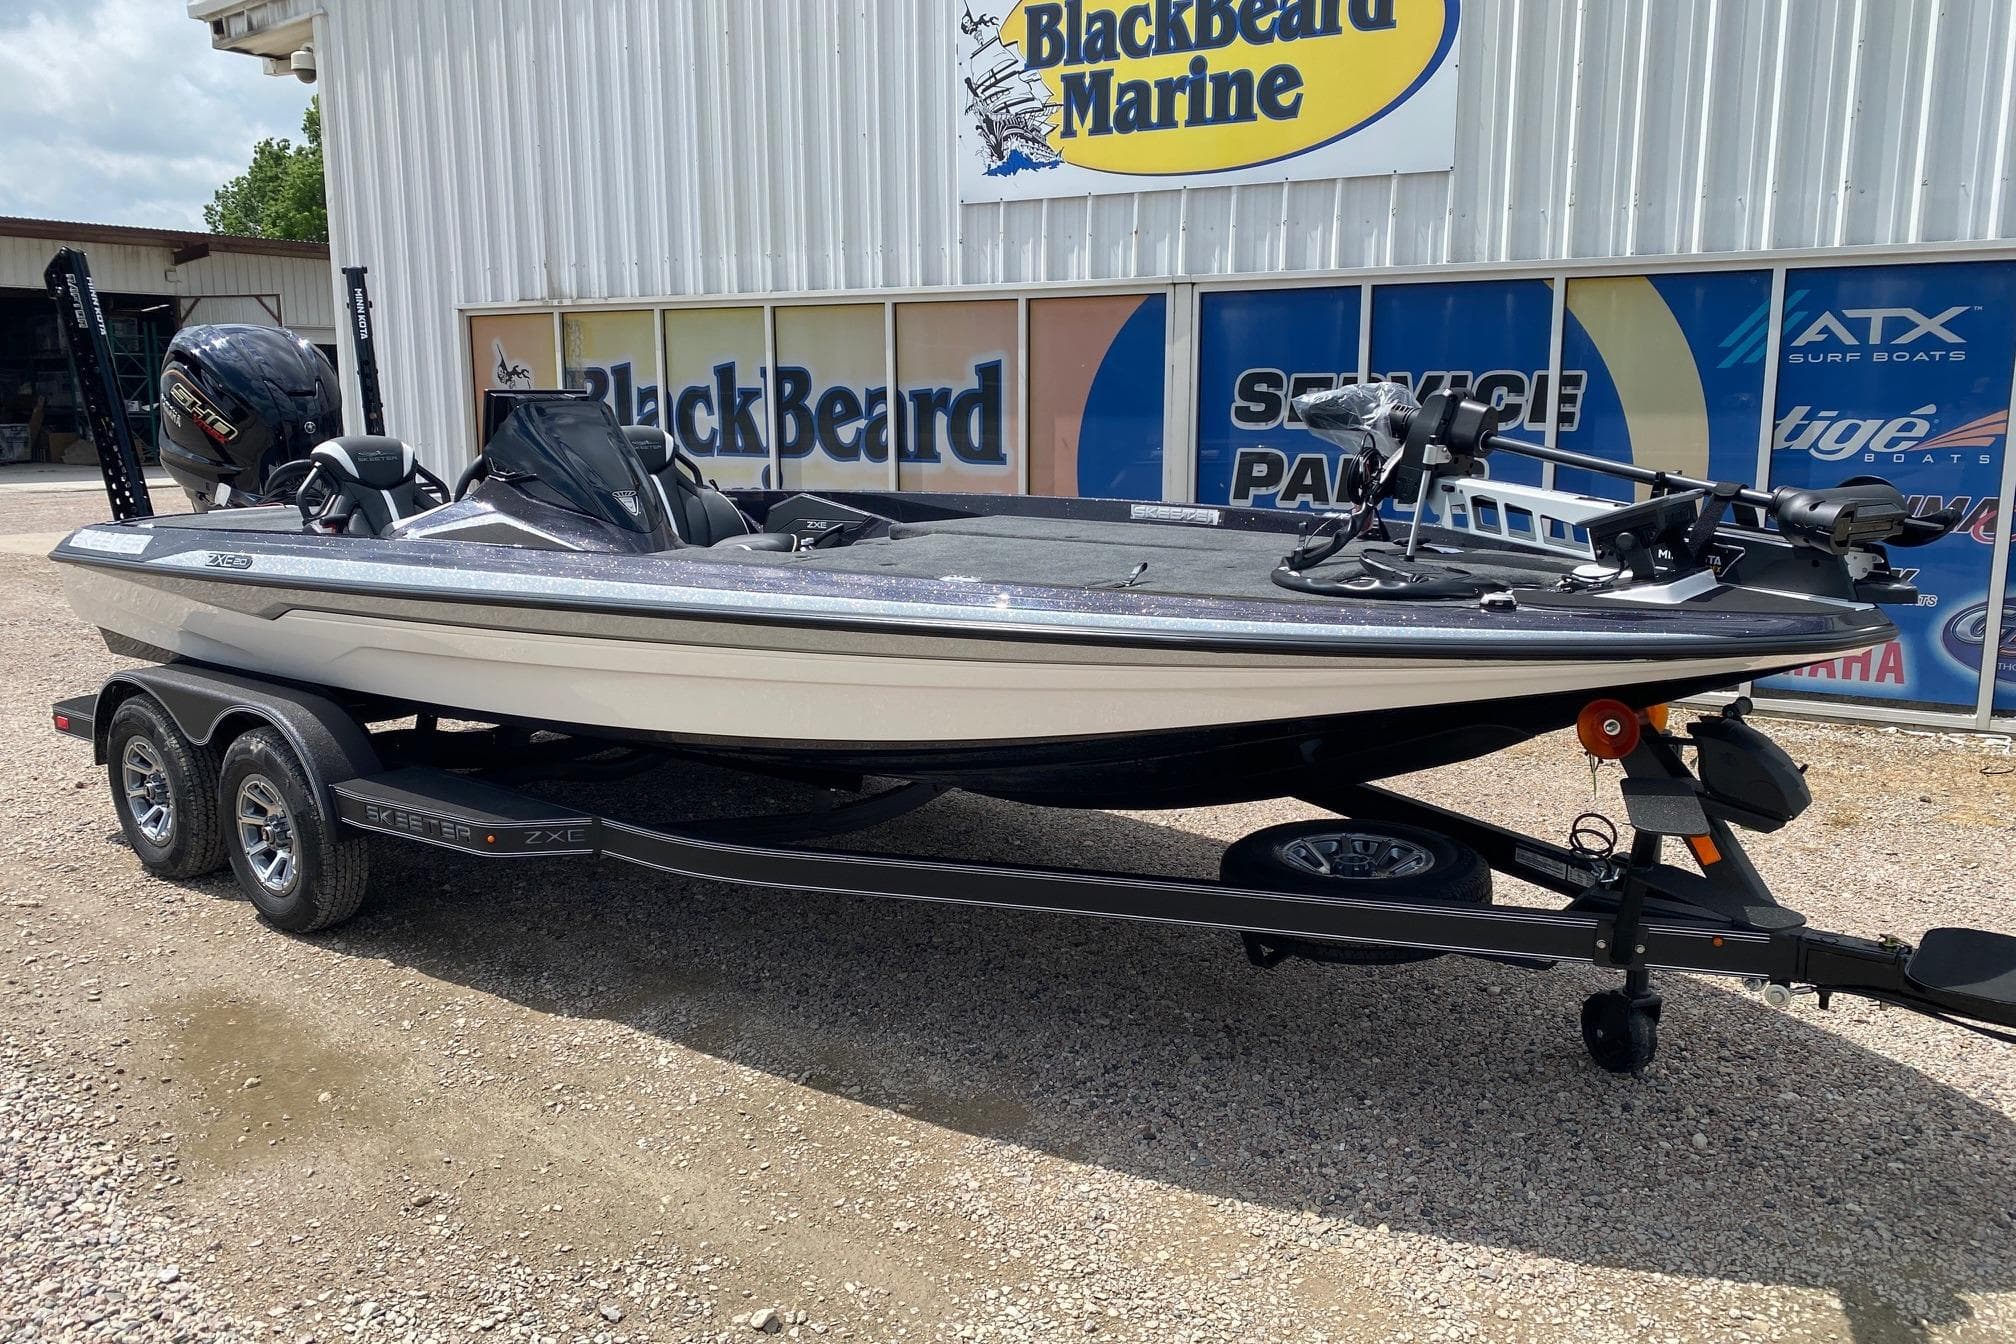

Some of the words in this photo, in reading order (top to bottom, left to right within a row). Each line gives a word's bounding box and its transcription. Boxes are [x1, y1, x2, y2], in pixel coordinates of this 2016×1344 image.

[1060, 55, 1304, 139] Marine
[354, 288, 365, 313] MINN
[94, 307, 107, 335] KOTA
[358, 314, 368, 340] KOTA
[1789, 305, 1971, 346] ATX
[1788, 352, 1862, 364] SURF
[1873, 350, 1967, 363] BOATS
[1231, 368, 1588, 432] SECE
[1772, 403, 1937, 462] tigé
[1864, 453, 1990, 464] BOATS
[806, 521, 827, 529] ZXE
[1132, 505, 1219, 525] SKEETER
[1658, 549, 1674, 560] MI
[1705, 555, 1722, 566] TA
[1783, 641, 1905, 684] AHA
[364, 804, 472, 843] SKEETER
[524, 829, 586, 845] ZXE
